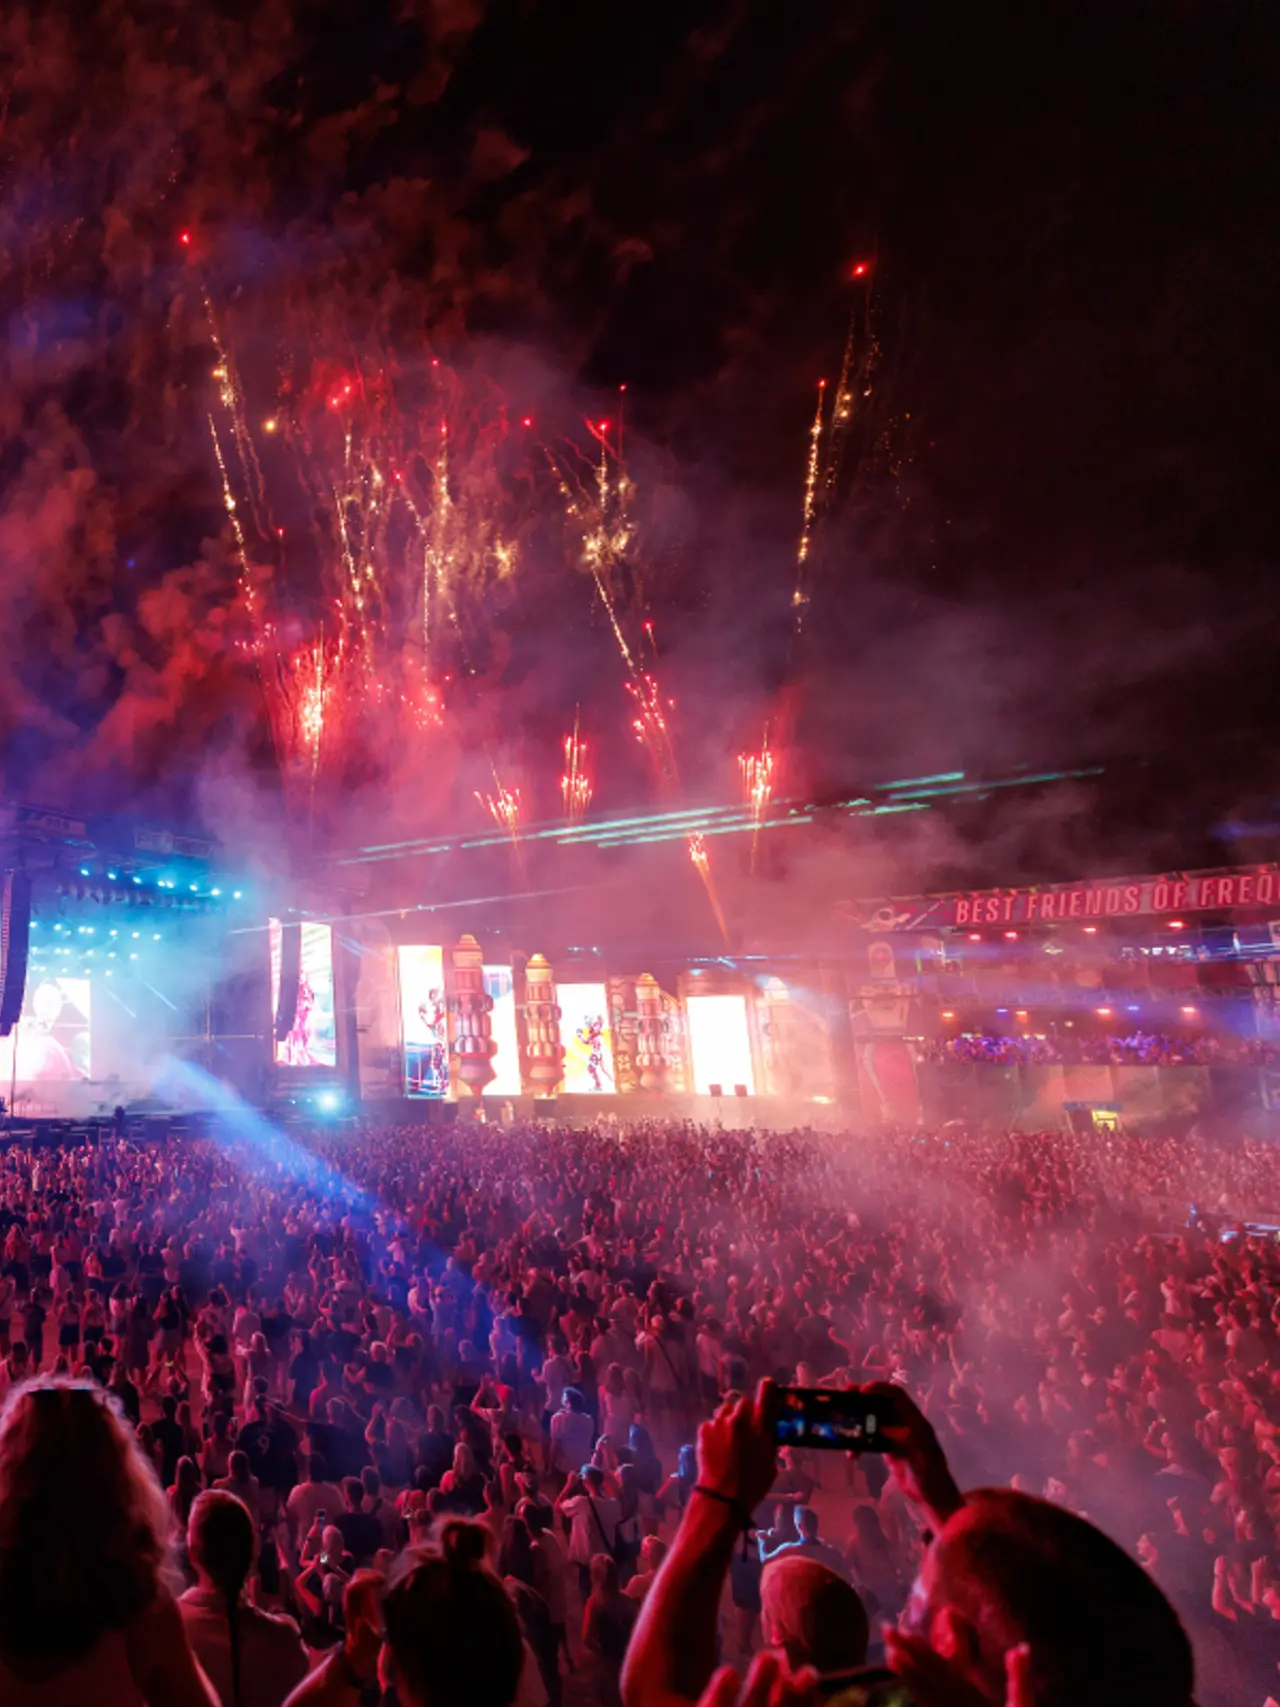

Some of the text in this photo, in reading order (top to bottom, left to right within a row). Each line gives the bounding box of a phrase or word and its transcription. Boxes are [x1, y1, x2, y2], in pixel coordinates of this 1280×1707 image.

[956, 874, 1280, 924] BEST FRIENDS OF FREQ
